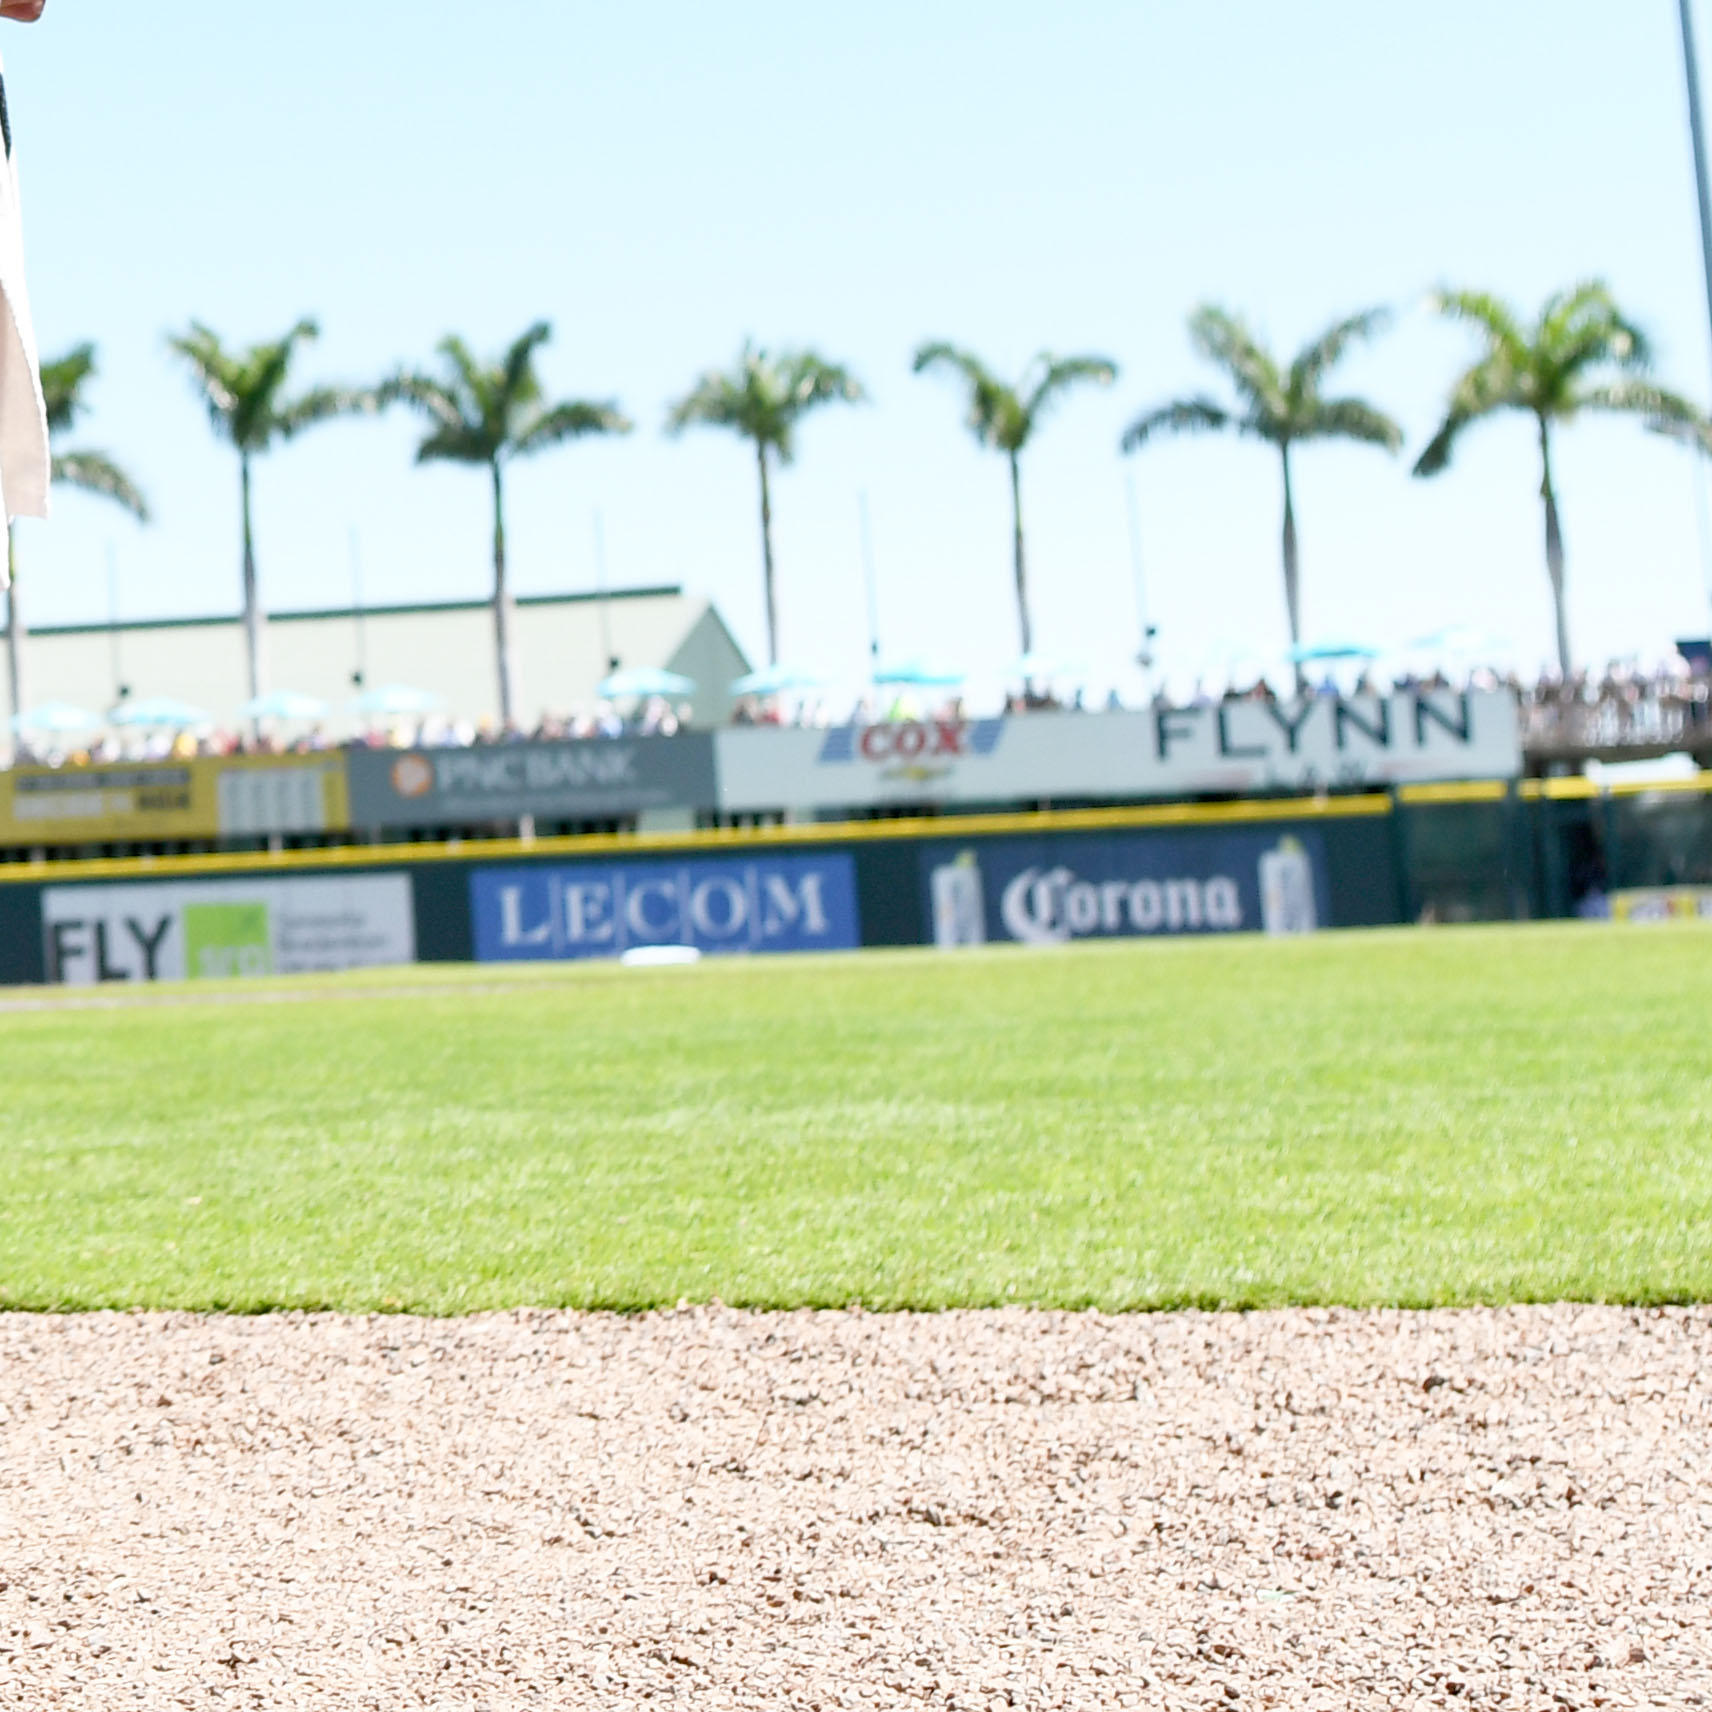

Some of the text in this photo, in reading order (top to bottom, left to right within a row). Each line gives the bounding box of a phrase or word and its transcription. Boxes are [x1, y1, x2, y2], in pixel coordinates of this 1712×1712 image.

[860, 718, 967, 763] COX
[1153, 682, 1473, 761] FLYNN
[499, 870, 830, 947] LECOM
[1001, 865, 1241, 943] Corona
[53, 914, 173, 983] FLY
